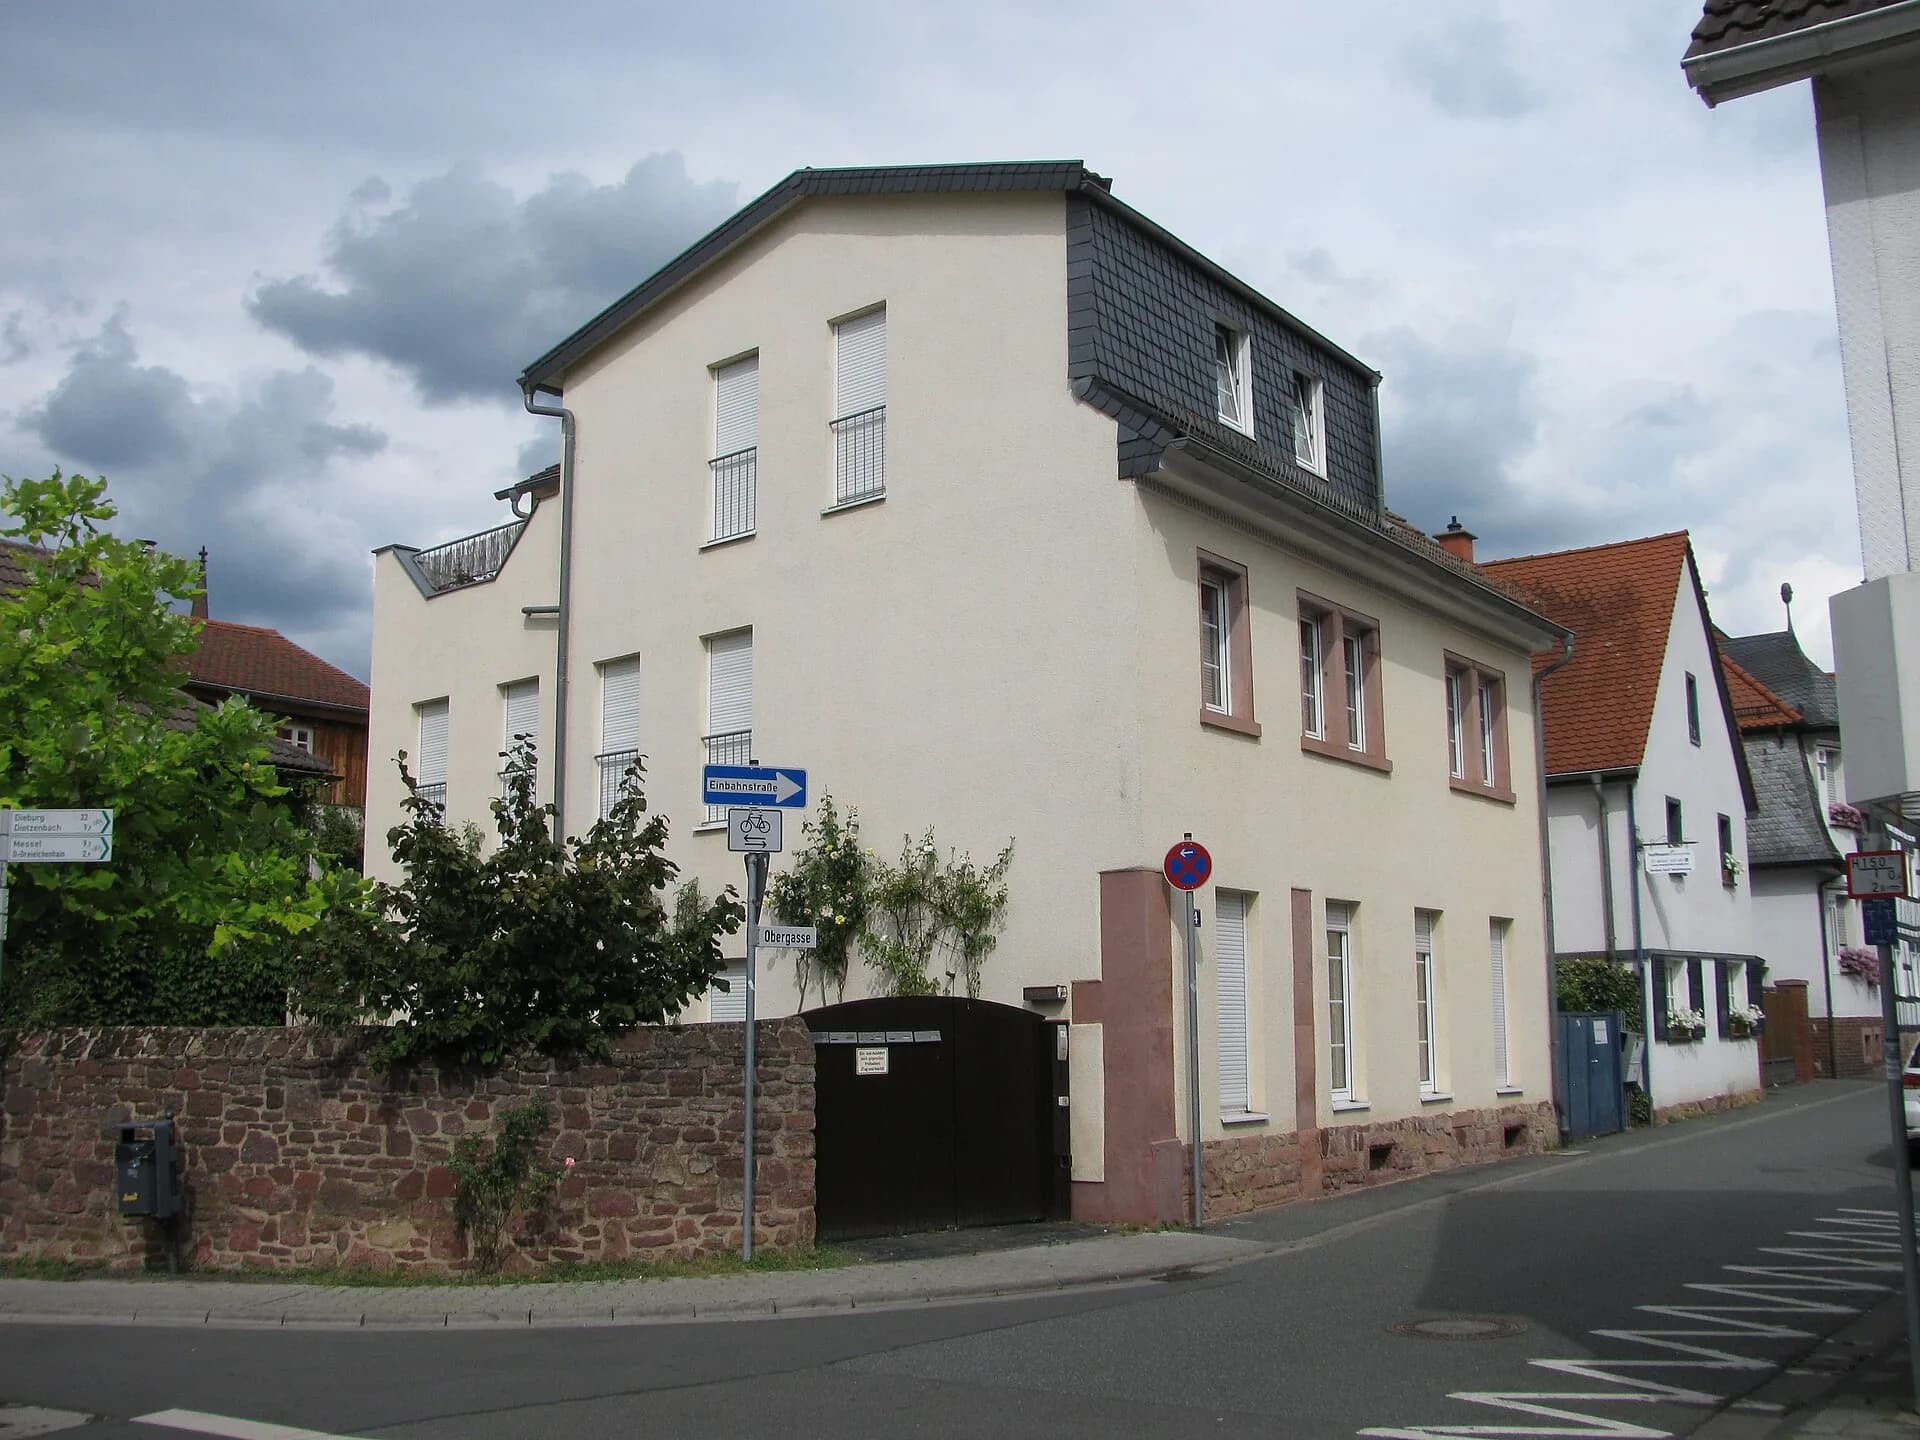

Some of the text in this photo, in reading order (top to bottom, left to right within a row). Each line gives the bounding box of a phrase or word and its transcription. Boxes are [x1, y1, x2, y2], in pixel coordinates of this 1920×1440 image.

[709, 780, 778, 792] Einbahnstraße
[14, 813, 89, 823] Dieburg 22
[14, 823, 62, 832] Dietzenbach
[13, 839, 42, 848] Messel
[764, 930, 811, 946] Obergasse
